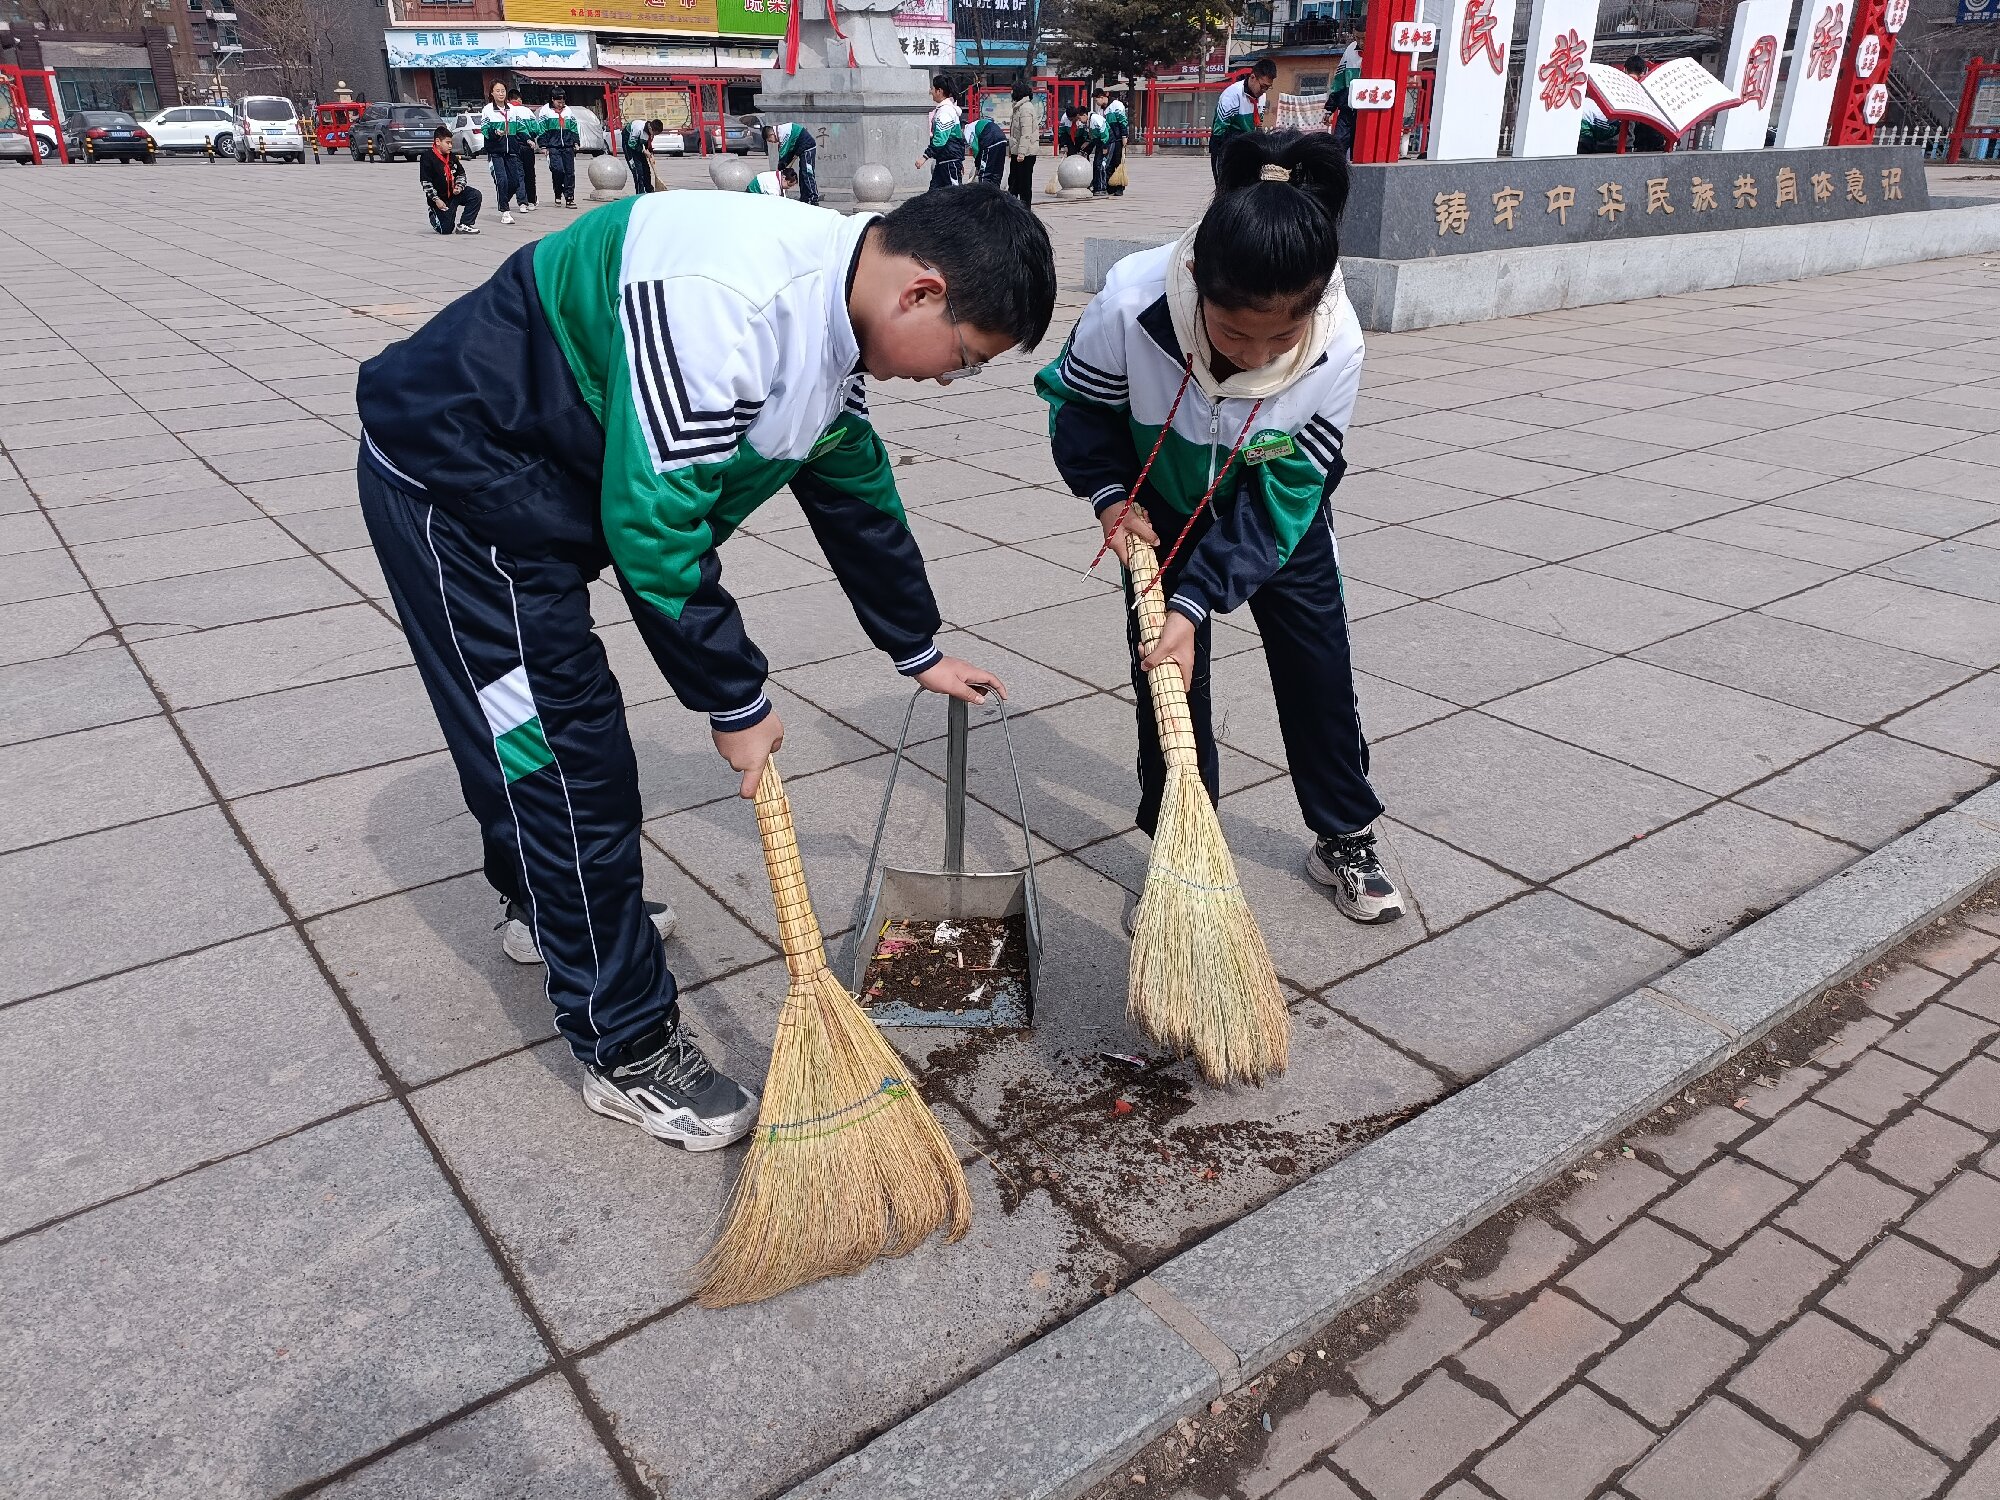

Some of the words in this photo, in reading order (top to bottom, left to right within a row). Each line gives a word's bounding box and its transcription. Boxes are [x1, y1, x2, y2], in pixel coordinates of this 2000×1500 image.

[415, 32, 479, 46] 有机蔬菜
[523, 32, 577, 47] 绿色果园
[1398, 27, 1432, 47] 共命运
[1433, 166, 1904, 237] 铸牢中华民族共同体意识
